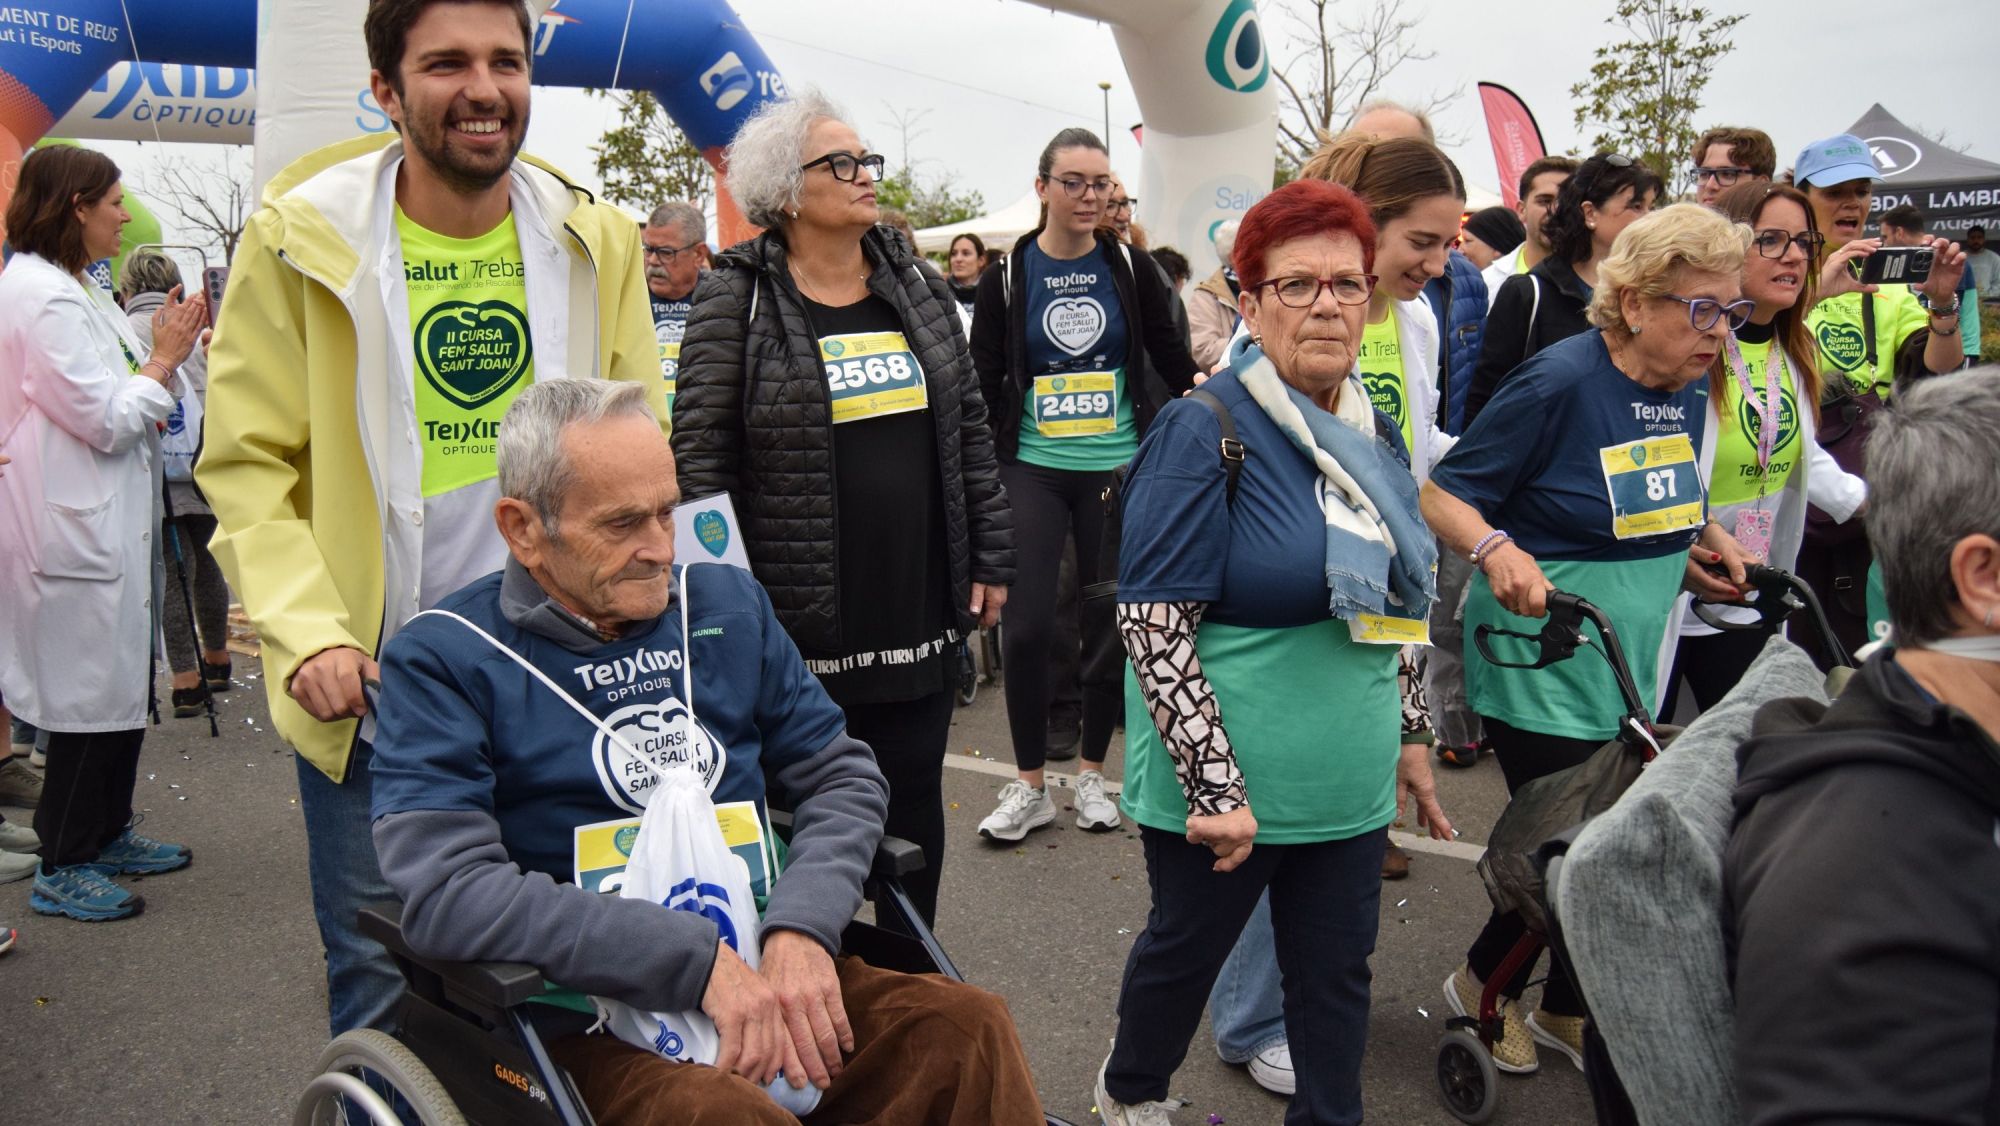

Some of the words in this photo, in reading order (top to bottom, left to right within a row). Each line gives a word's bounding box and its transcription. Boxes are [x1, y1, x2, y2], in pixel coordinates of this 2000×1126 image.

[56, 15, 80, 35] DE
[84, 22, 119, 43] REUS
[19, 31, 26, 44] i
[30, 33, 82, 55] Esports
[404, 260, 459, 281] Salut
[424, 283, 435, 291] de
[474, 280, 485, 289] de
[486, 279, 512, 288] Riscos
[1054, 286, 1089, 296] OPTIQUES
[1056, 321, 1071, 329] FEM
[1072, 318, 1095, 327] SALUT
[1065, 311, 1089, 320] CURSA
[446, 331, 455, 344] II
[460, 328, 503, 342] CURSA
[1057, 328, 1075, 336] SANT
[1077, 326, 1096, 334] JOAN
[439, 345, 466, 359] FEM
[468, 342, 513, 356] SALUT
[440, 359, 475, 373] SANT
[476, 357, 512, 371] JOAN
[825, 354, 912, 391] 2568
[1042, 393, 1109, 417] 2459
[1645, 423, 1682, 432] OPTIQUES
[1645, 468, 1677, 501] 87
[805, 660, 841, 674] TURN
[857, 652, 875, 667] UP
[878, 648, 914, 665] TURN
[607, 677, 672, 702] OPTIQUES
[644, 730, 688, 754] CURSA
[495, 1064, 529, 1092] GADES
[529, 1085, 546, 1102] gap
